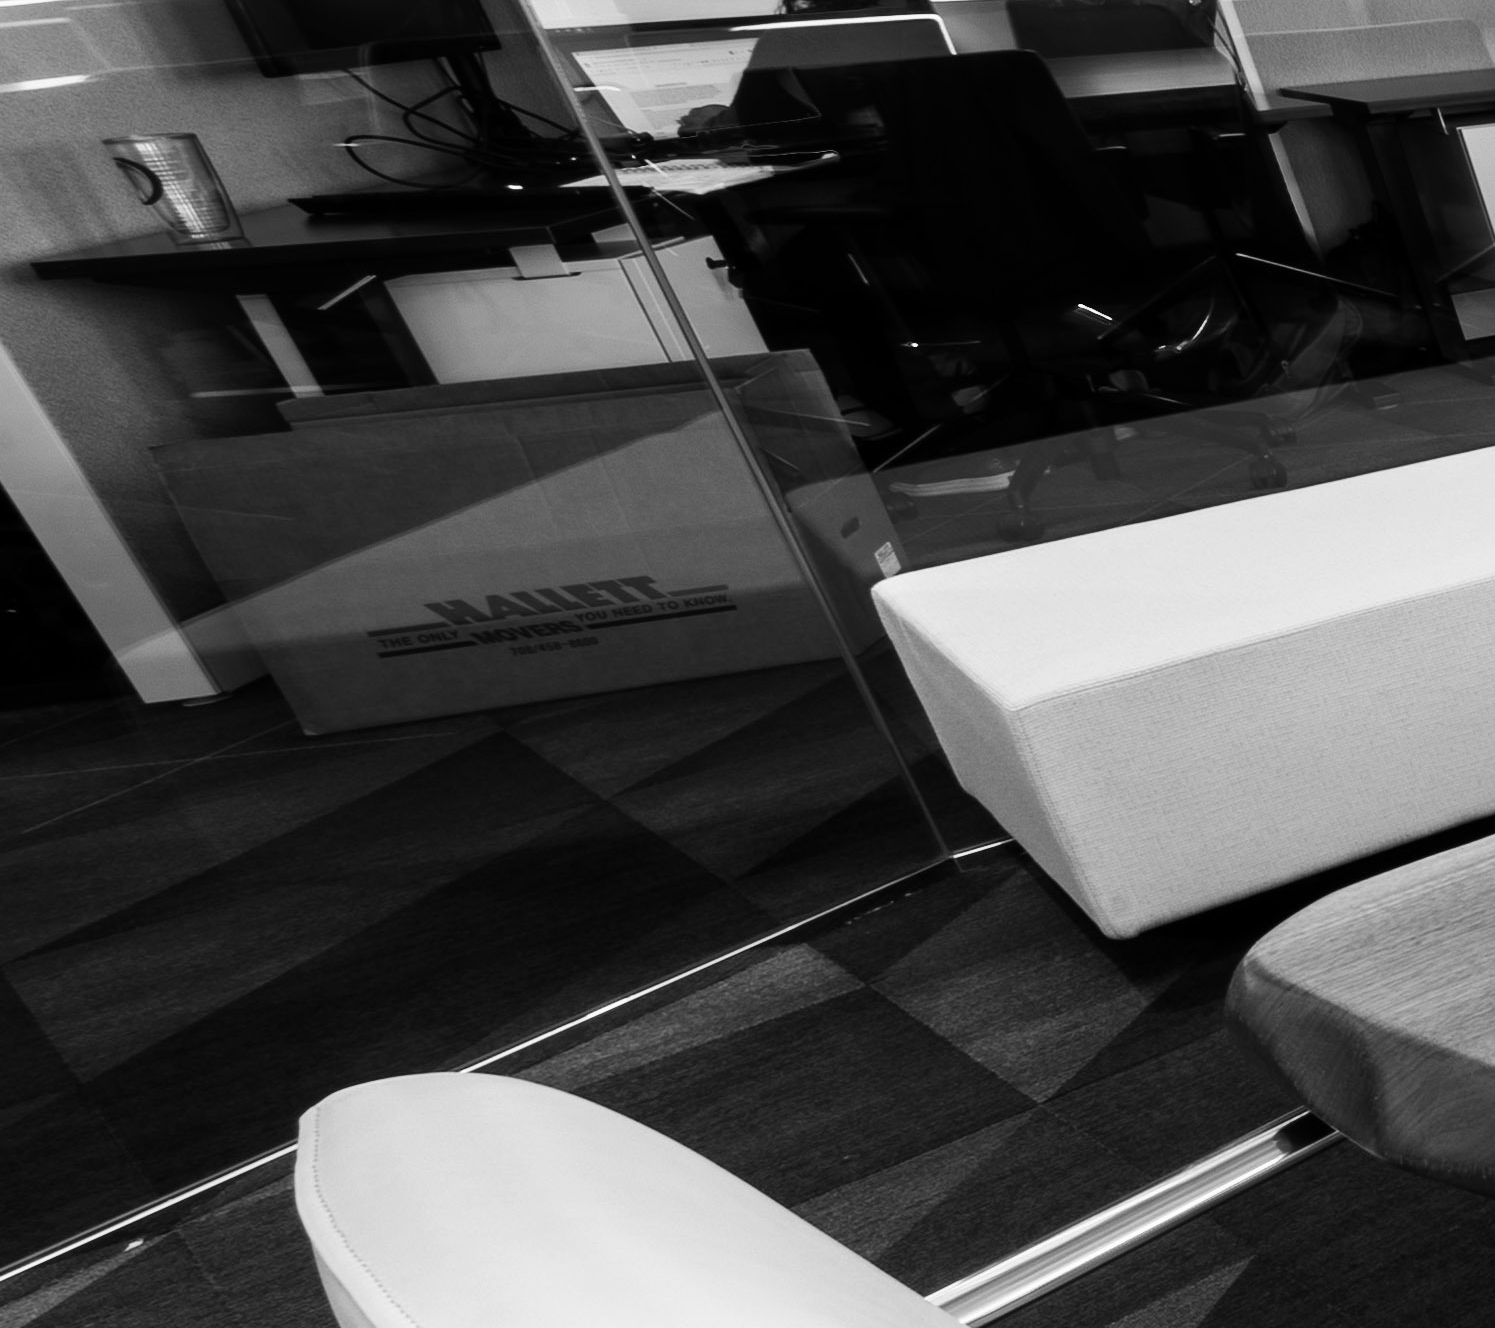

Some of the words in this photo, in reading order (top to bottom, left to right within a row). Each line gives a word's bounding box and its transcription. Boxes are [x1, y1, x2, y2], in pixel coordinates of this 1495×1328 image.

[376, 636, 414, 649] THE
[417, 630, 459, 645] ONLY
[470, 621, 583, 645] MOVERS
[574, 608, 607, 623] YOU
[611, 604, 653, 618] NEED
[656, 600, 679, 611] TO
[683, 593, 733, 609] KNOW.
[424, 575, 656, 626] HALLETT
